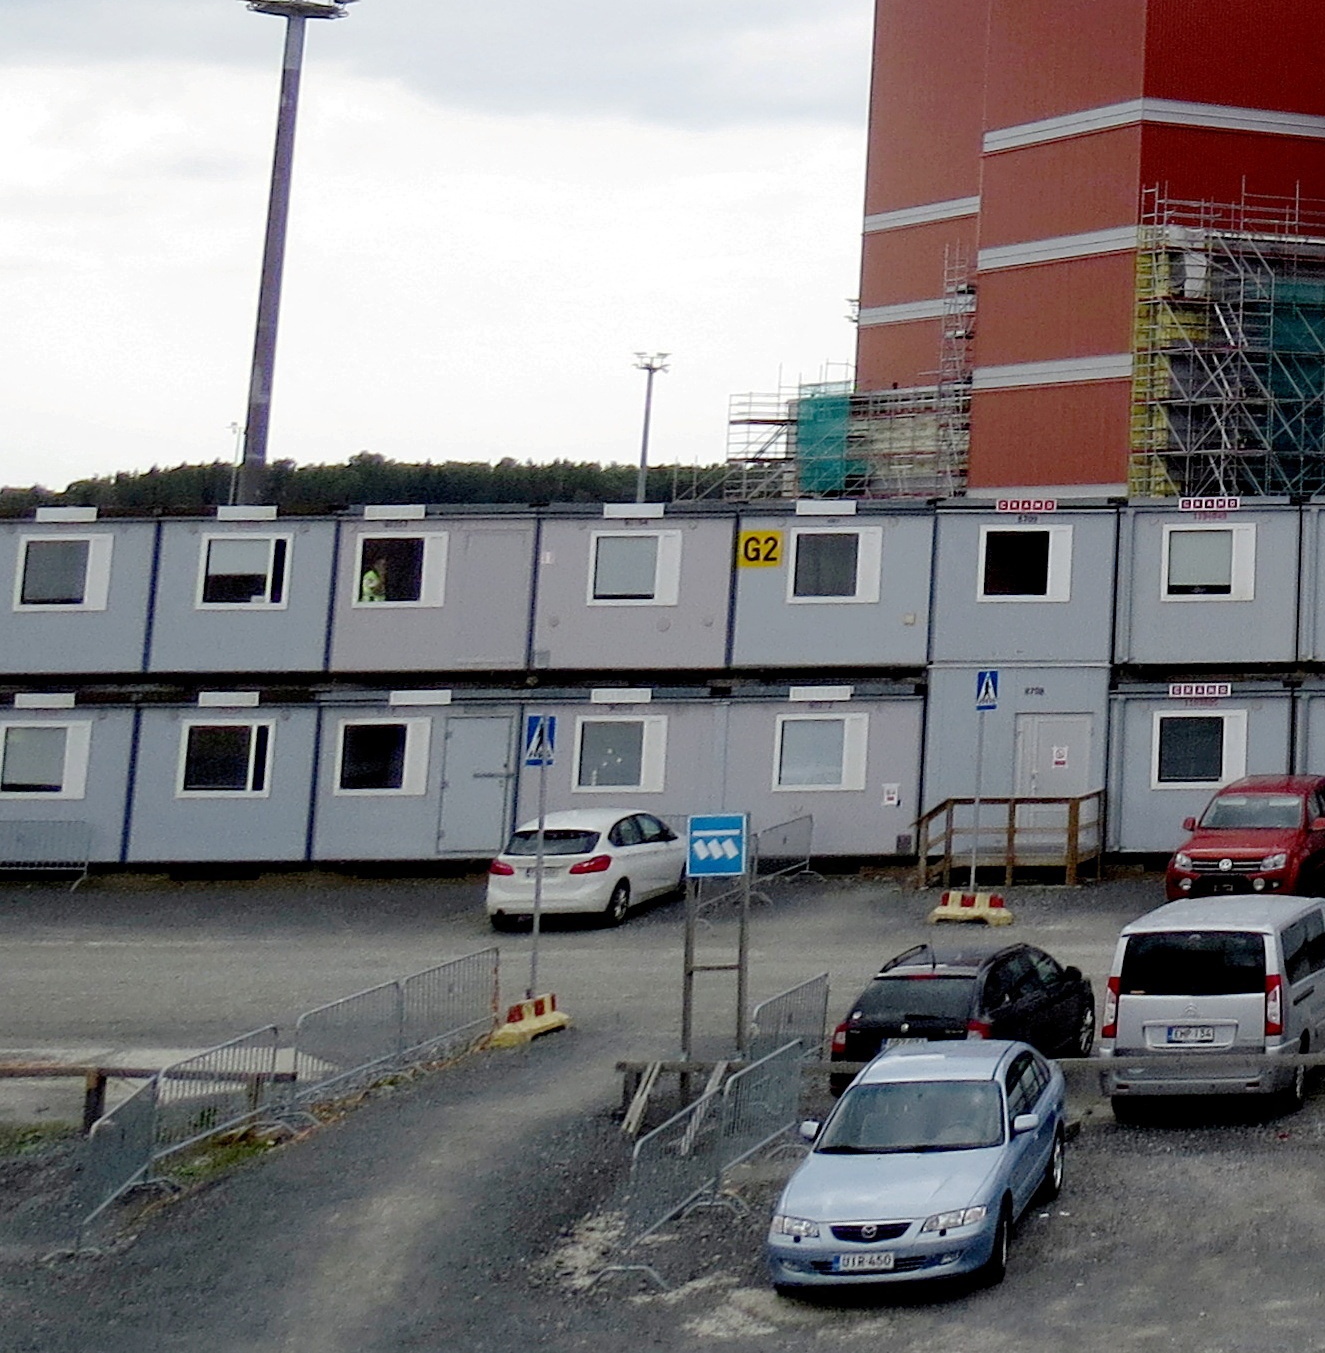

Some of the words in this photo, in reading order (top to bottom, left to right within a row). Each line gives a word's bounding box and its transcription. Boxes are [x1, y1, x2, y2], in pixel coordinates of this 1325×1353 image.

[998, 500, 1055, 510] CRAMO
[1181, 498, 1238, 509] CRAMO
[743, 536, 779, 562] G2
[1172, 685, 1229, 695] CRAMO
